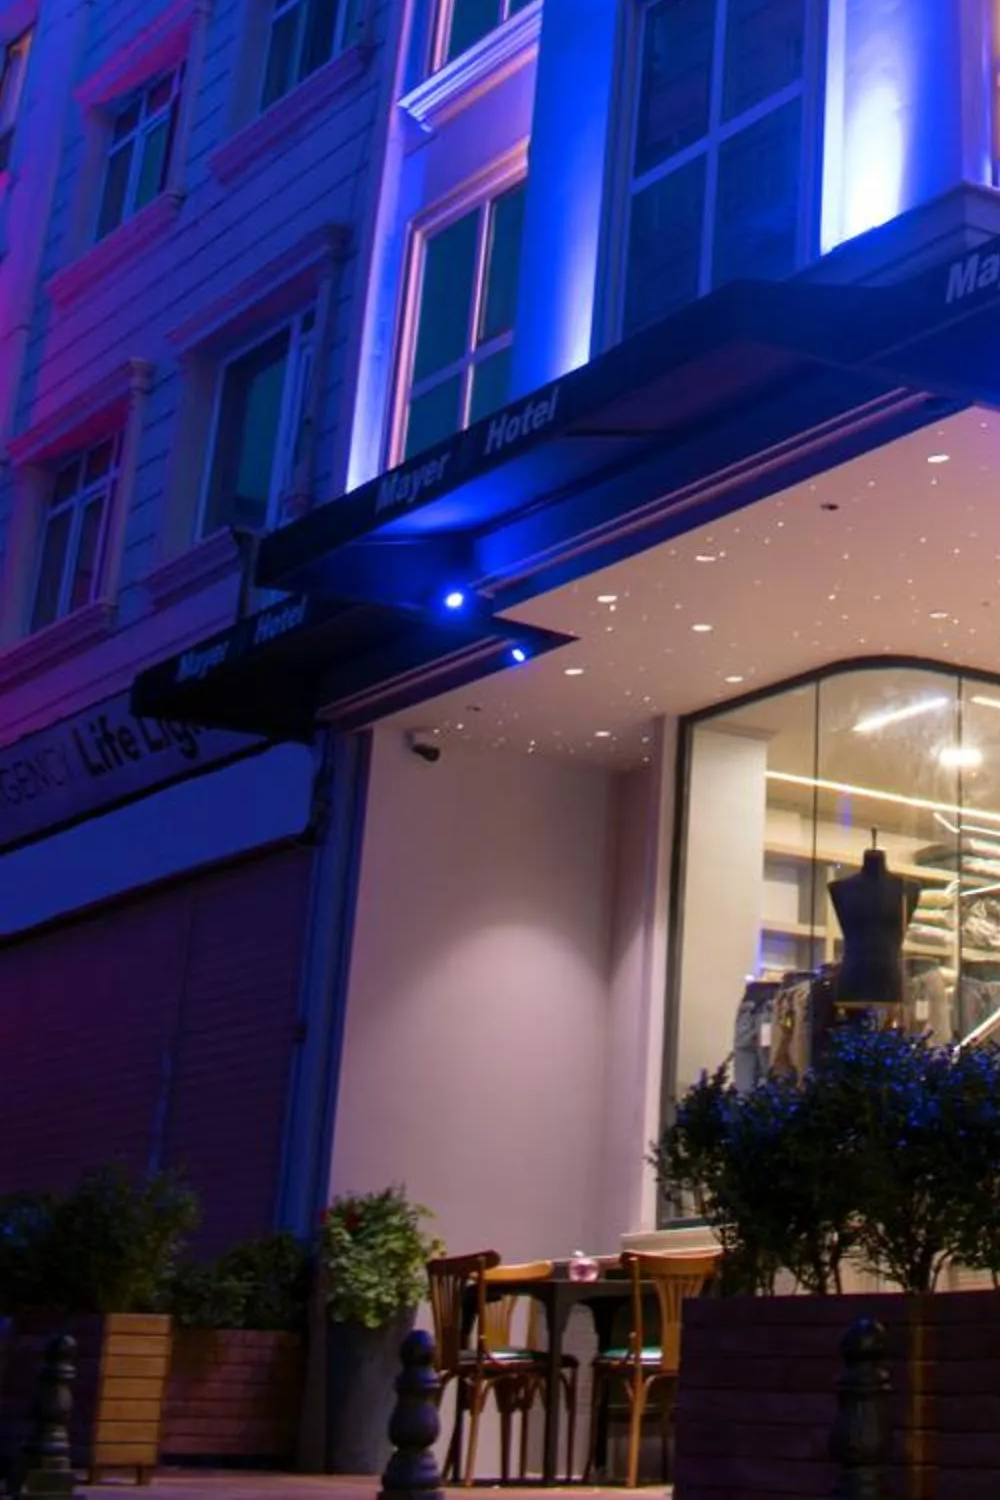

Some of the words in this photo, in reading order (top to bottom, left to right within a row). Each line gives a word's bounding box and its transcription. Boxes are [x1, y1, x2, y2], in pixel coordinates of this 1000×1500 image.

[374, 450, 452, 516] Mayer
[483, 385, 561, 456] Hotel
[73, 715, 141, 777] Life
